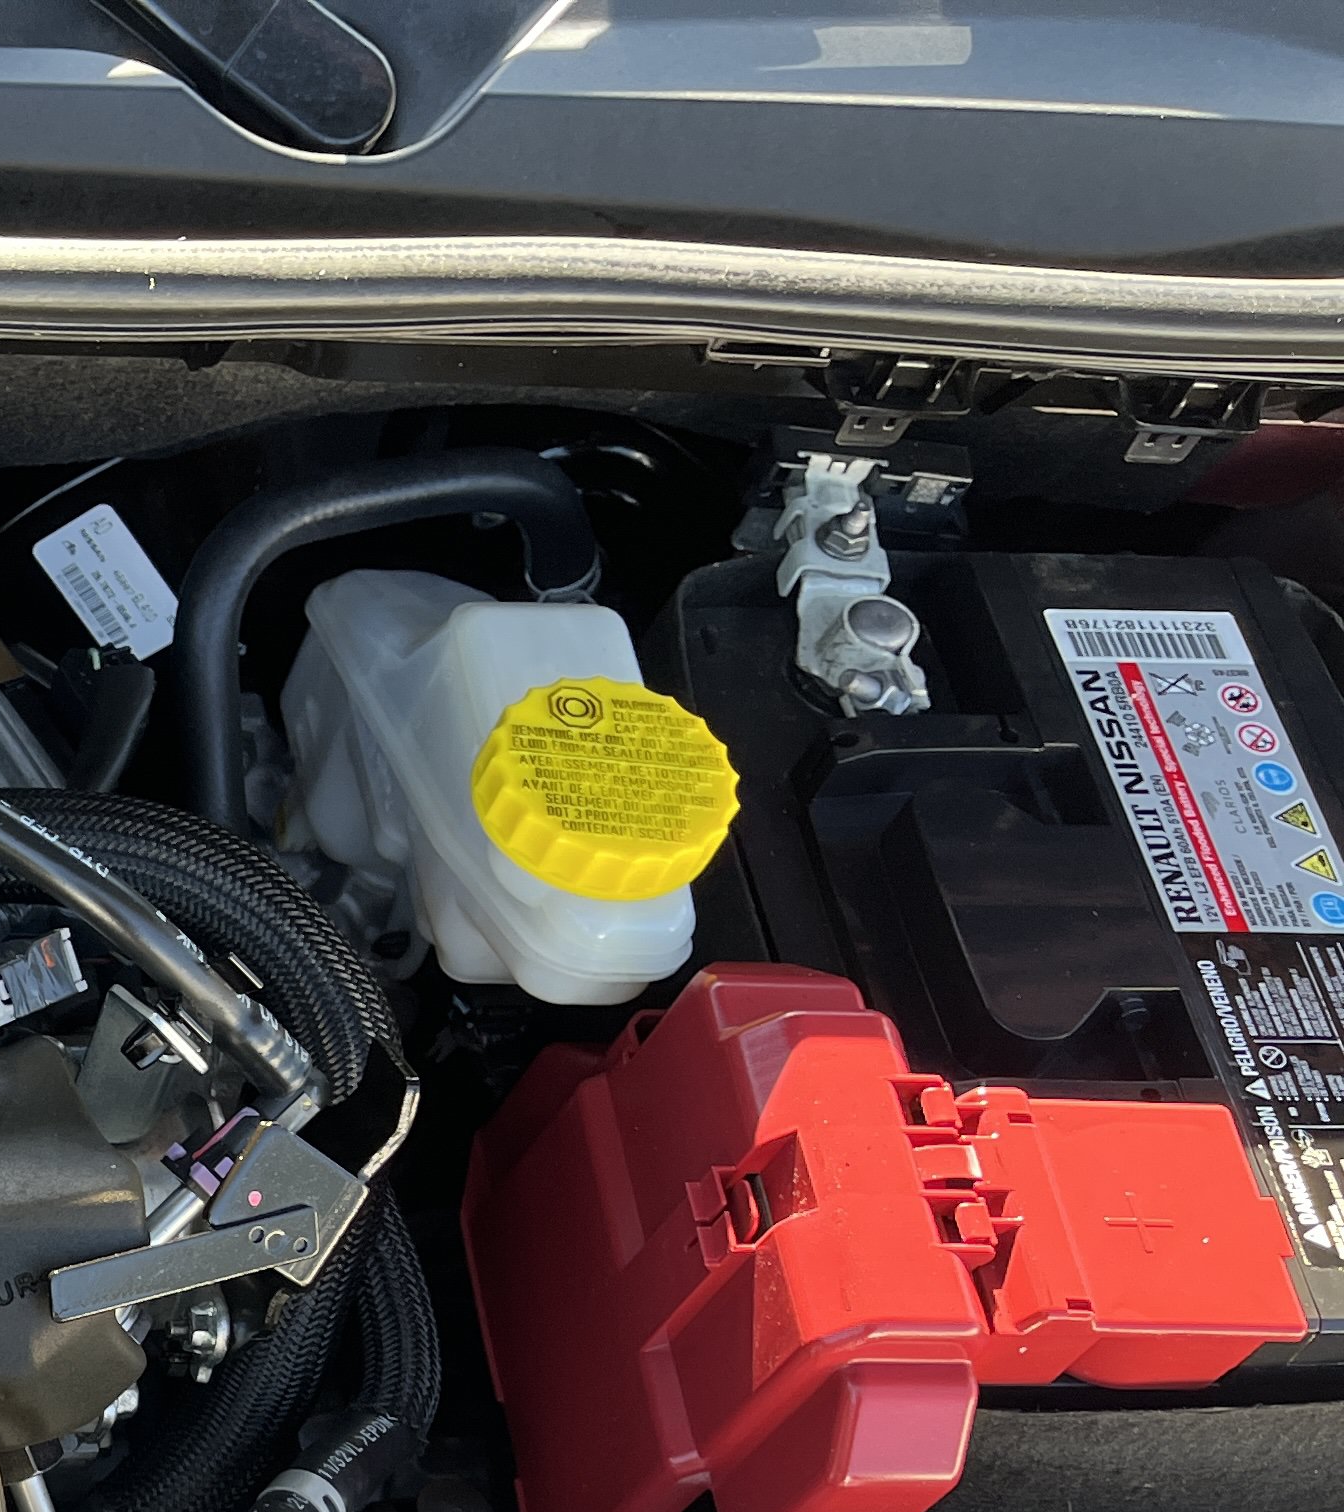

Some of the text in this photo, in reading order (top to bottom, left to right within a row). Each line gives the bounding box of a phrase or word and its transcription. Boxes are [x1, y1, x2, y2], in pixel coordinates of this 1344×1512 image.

[1130, 679, 1162, 734] technology
[580, 731, 602, 744] USE
[605, 733, 637, 747] ONLY
[641, 736, 663, 749] DOT
[614, 723, 639, 736] CAP
[1125, 714, 1147, 748] 24410
[512, 736, 547, 750] FLUID
[551, 740, 585, 754] FROM
[591, 745, 600, 756] A
[604, 746, 653, 761] SEALED
[1156, 736, 1180, 772] Special
[545, 794, 618, 810] SEULEMENT
[623, 799, 640, 812] DU
[569, 783, 586, 795] DE
[1076, 670, 1204, 925] RENAULT NISSAN
[1174, 780, 1198, 817] Battery
[546, 805, 571, 818] DOT
[1214, 779, 1246, 834] CLARIOS
[1188, 820, 1214, 861] Flooded
[1181, 856, 1202, 879] EFB
[1191, 880, 1208, 895] L2
[1203, 863, 1237, 916] Enhanced
[1203, 904, 1220, 923] 12V
[1197, 959, 1260, 1076] PELIGRO/VENENO
[1255, 1106, 1319, 1226] DANGER/POISON
